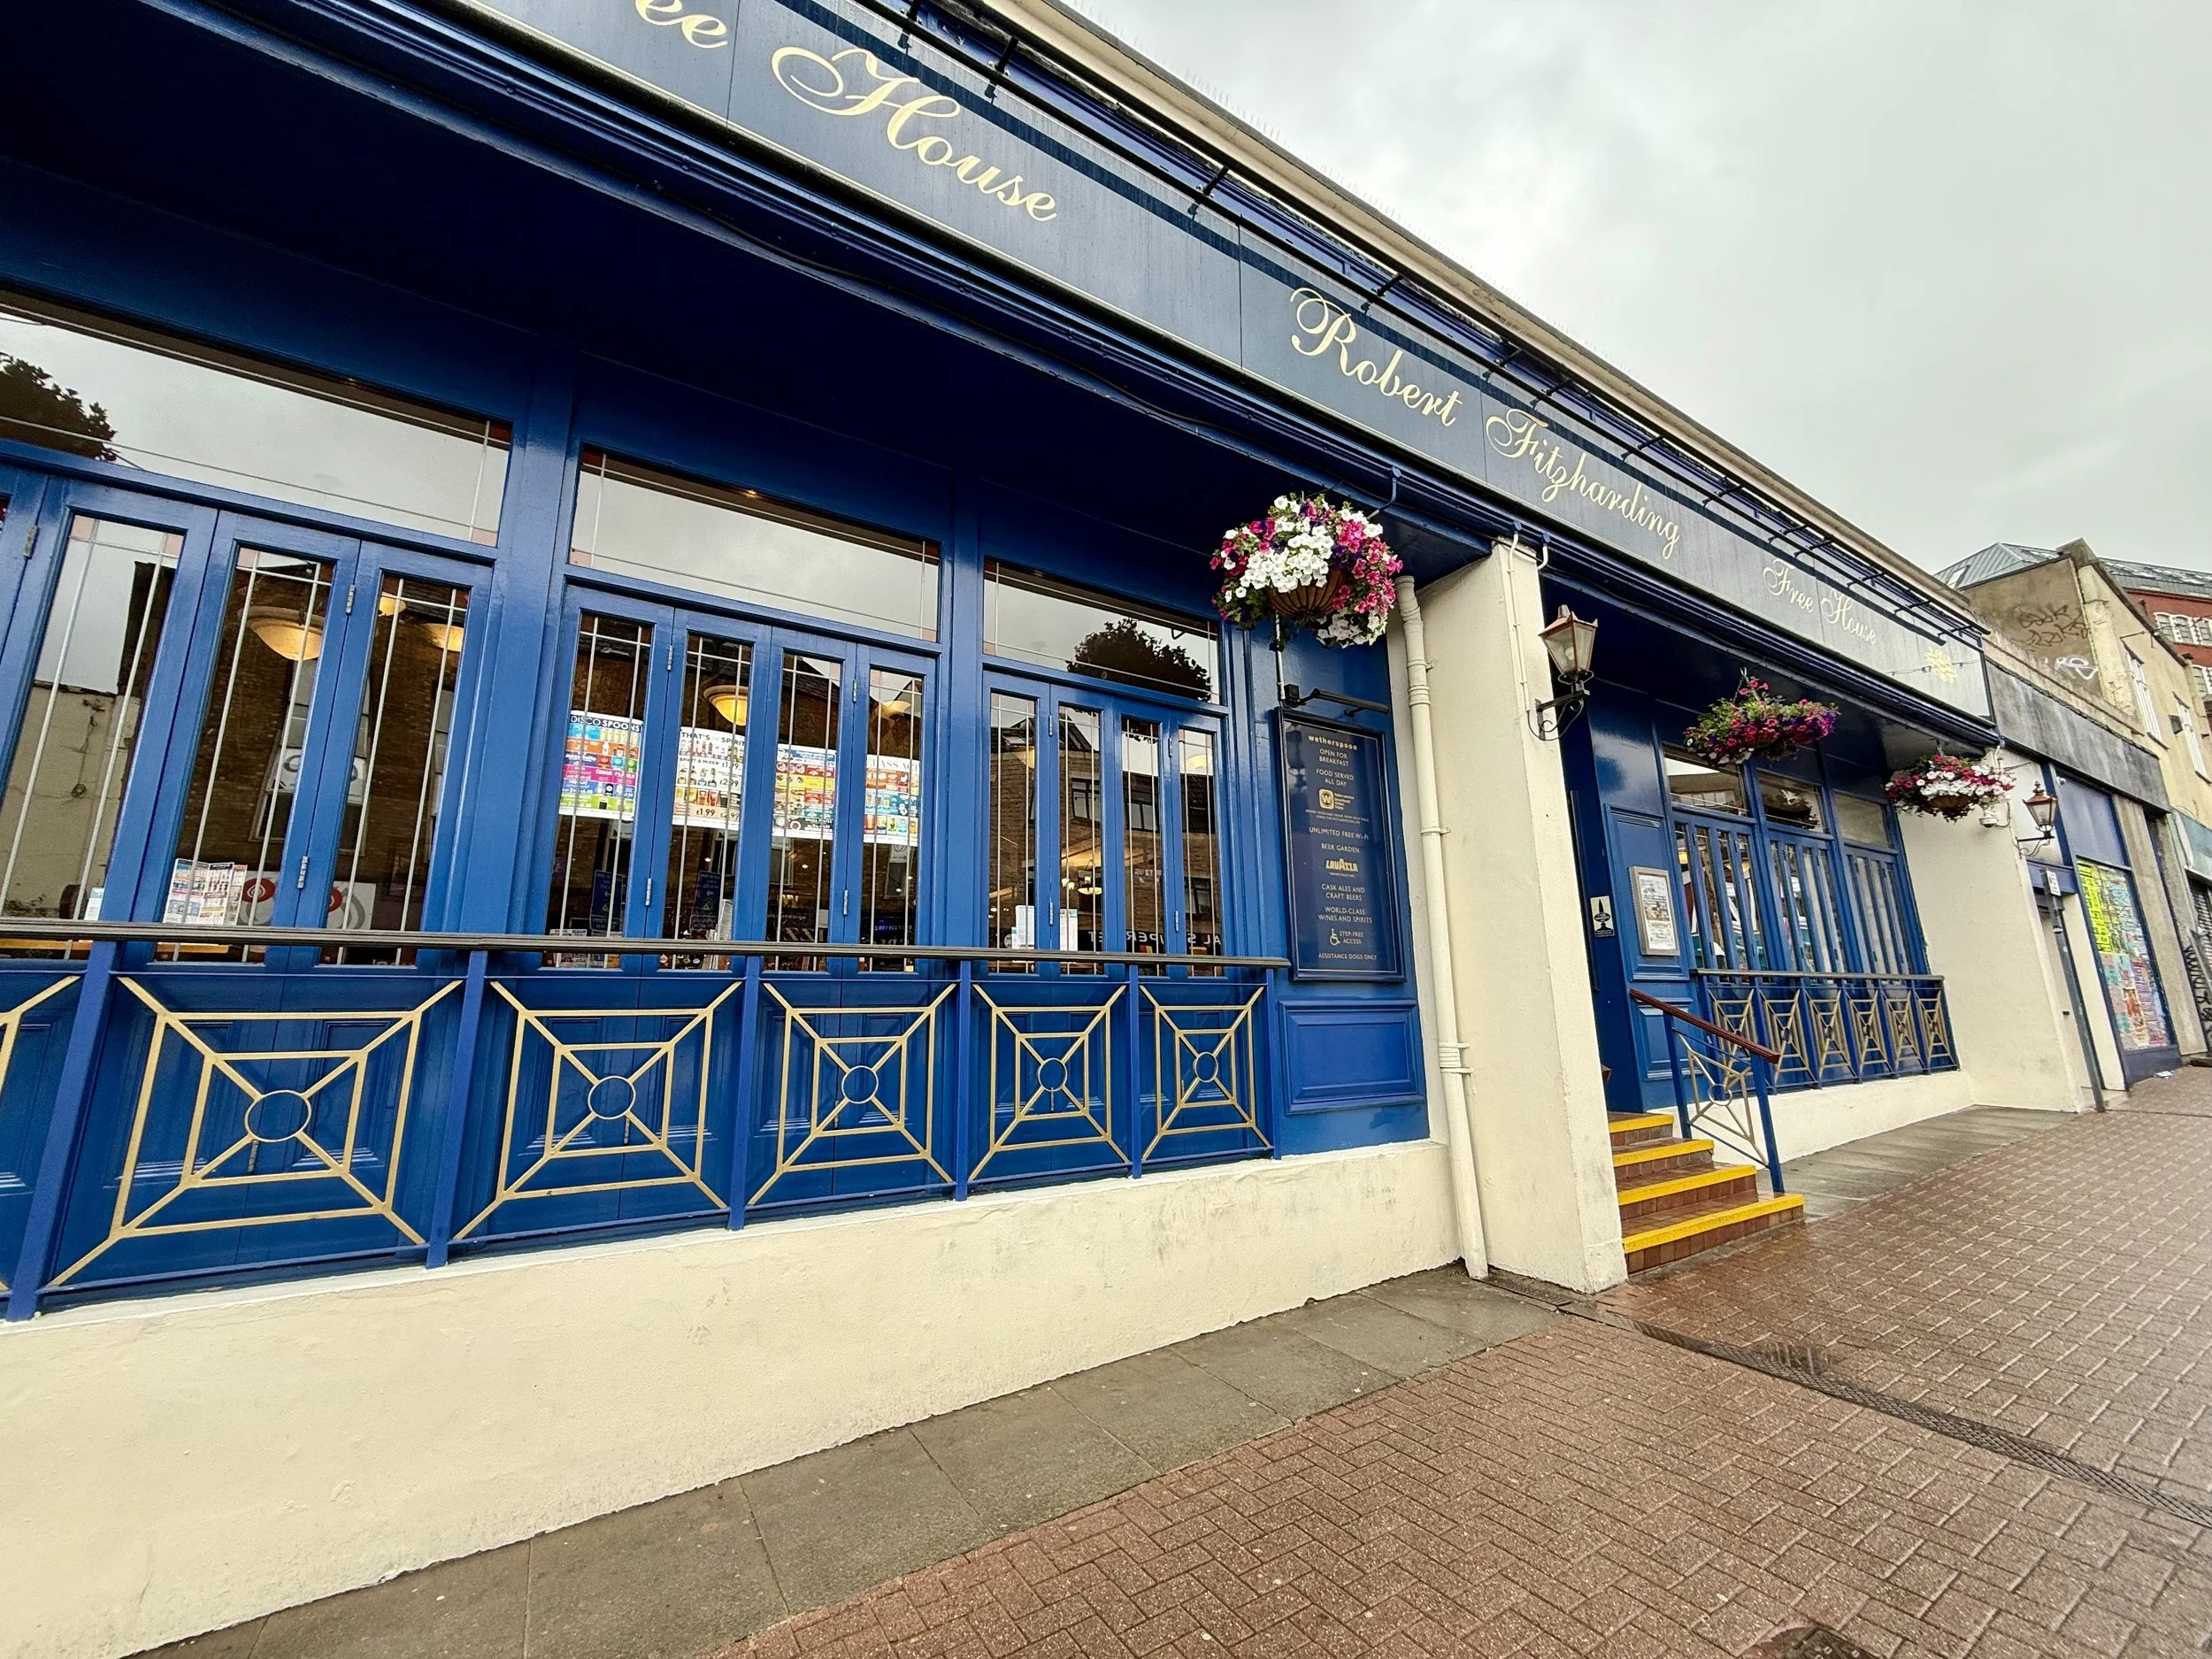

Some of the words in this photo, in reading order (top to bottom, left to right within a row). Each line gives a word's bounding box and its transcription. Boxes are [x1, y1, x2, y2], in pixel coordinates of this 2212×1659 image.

[772, 47, 1057, 221] House
[1290, 288, 1463, 426] Robert
[1486, 409, 1680, 559] Fitzharding
[1763, 558, 1814, 612] Free
[1820, 588, 1876, 644] House
[571, 715, 601, 726] DISCO
[681, 732, 710, 741] THAT'S
[721, 737, 745, 746] SPRIT
[1309, 735, 1358, 750] wetherspoon
[1319, 756, 1348, 766] BREAKFAST
[1334, 772, 1354, 780] SERVED
[1309, 827, 1340, 836] UNLIMITED
[1326, 858, 1358, 872] LAVAZZA
[1324, 906, 1366, 915] WORLD-CLASS
